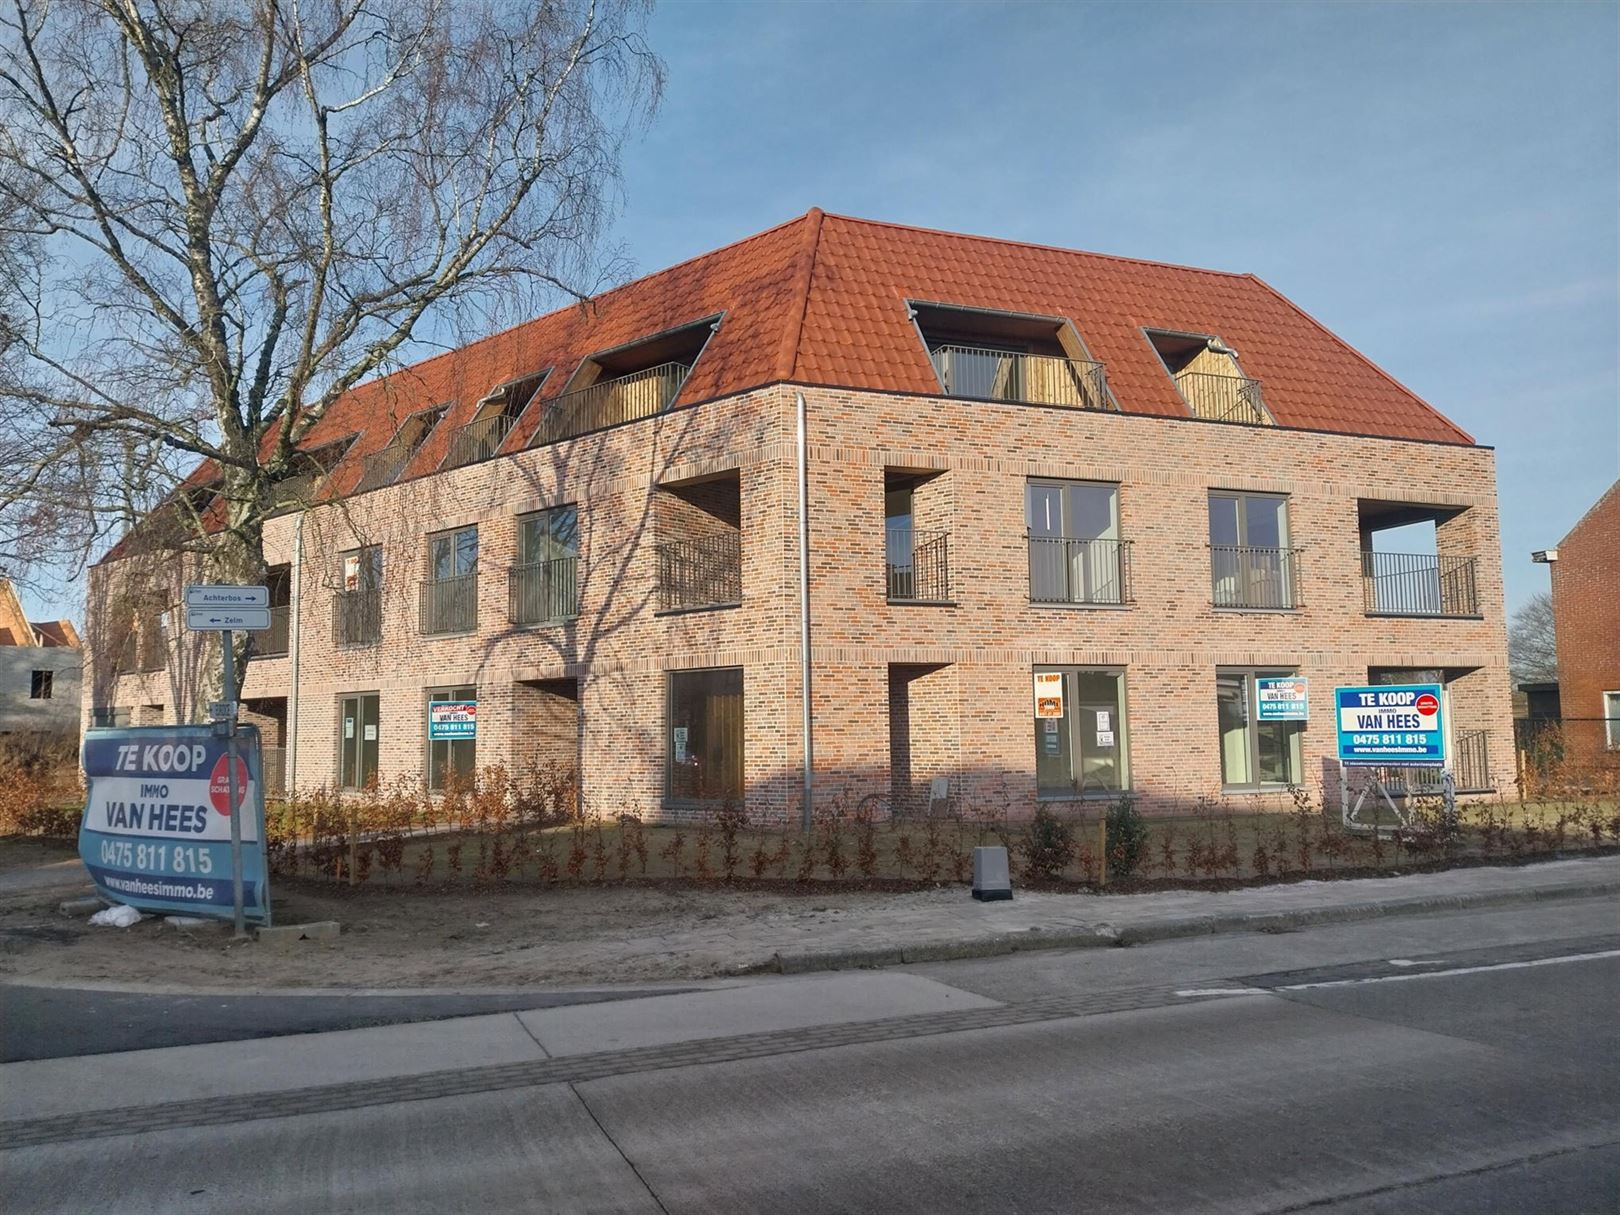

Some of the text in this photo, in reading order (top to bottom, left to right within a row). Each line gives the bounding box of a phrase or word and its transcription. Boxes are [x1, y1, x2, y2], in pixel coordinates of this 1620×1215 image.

[203, 594, 241, 602] Achterbos
[1359, 692, 1415, 706] TE KOOP
[1357, 714, 1420, 729] VAN HEES
[1353, 734, 1427, 745] 0475 811 815
[115, 744, 207, 772] TE KOOP
[140, 783, 168, 798] IMMO
[106, 801, 208, 833] VAN HEES
[101, 839, 212, 874] 0475 811 815
[104, 875, 214, 899] www.vanheesimmo.be
